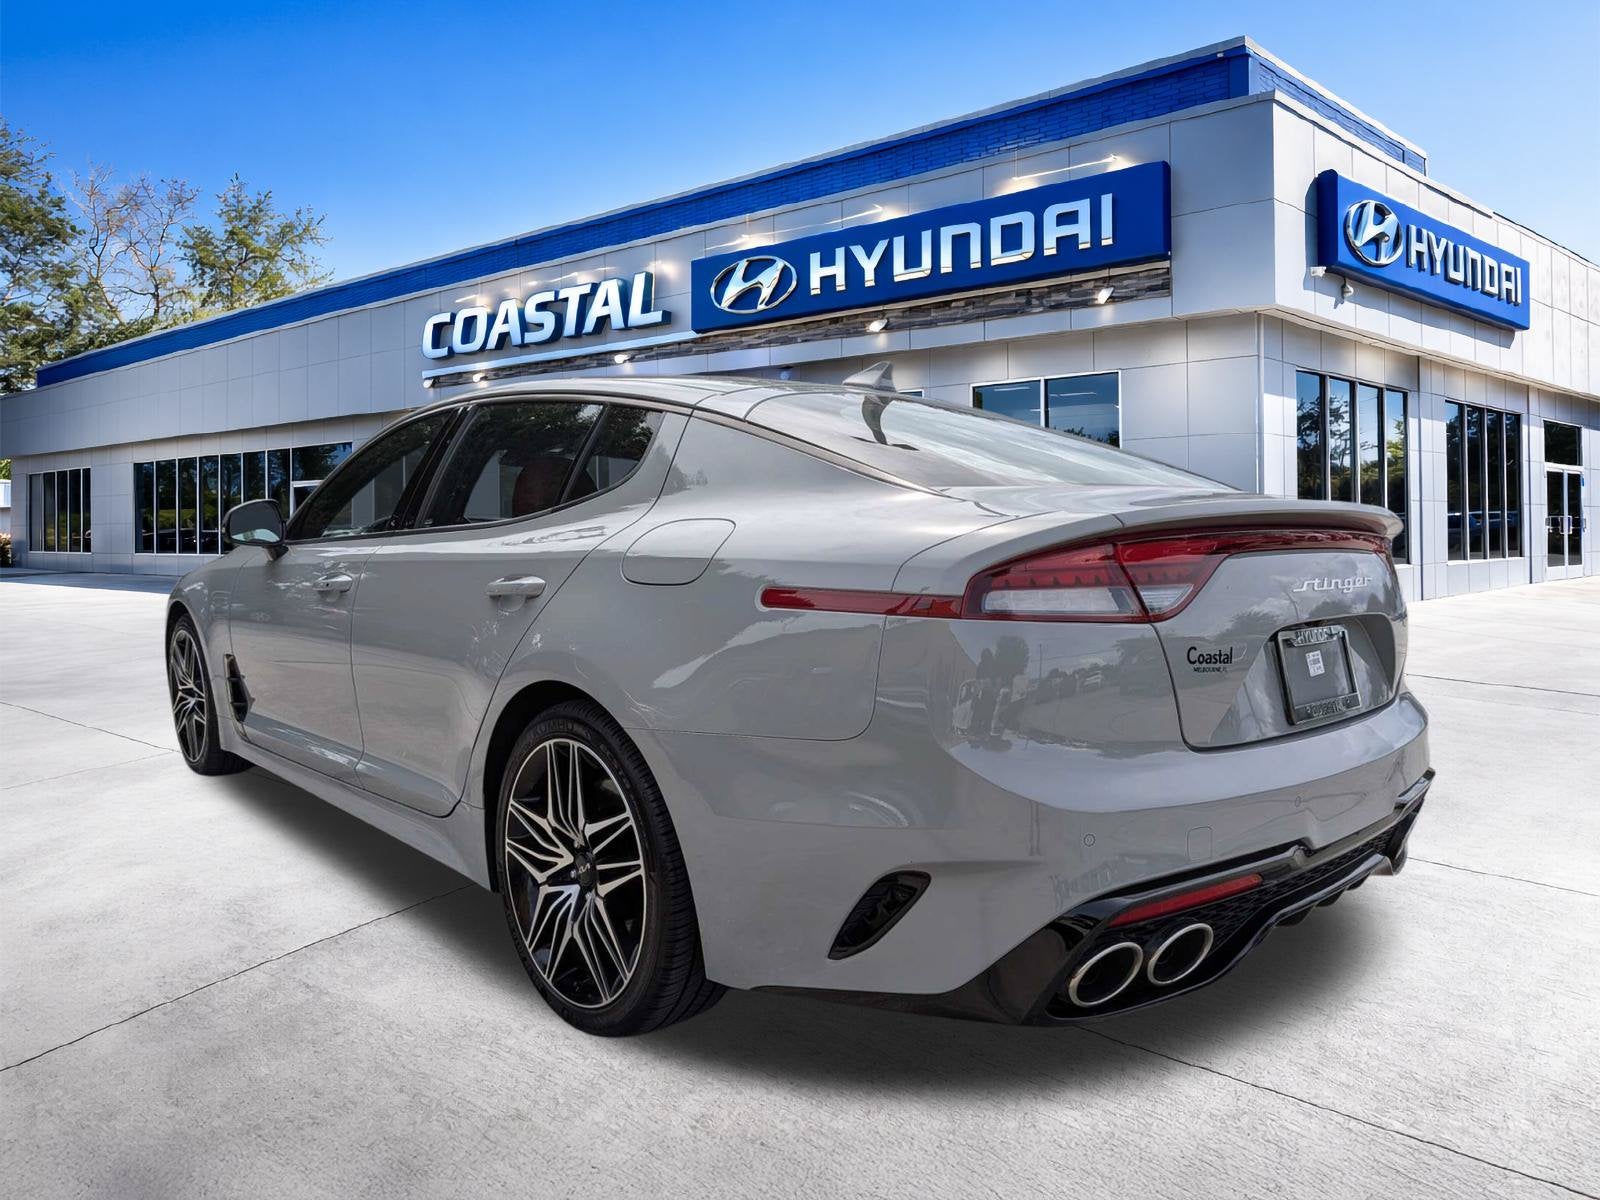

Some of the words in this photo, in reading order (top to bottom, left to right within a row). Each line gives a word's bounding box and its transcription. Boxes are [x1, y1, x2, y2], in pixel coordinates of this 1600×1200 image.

[808, 193, 1115, 296] HYUNDAI
[1407, 224, 1522, 306] HYUNDAI
[422, 271, 669, 359] COASTAL
[1187, 646, 1233, 665] Coastal
